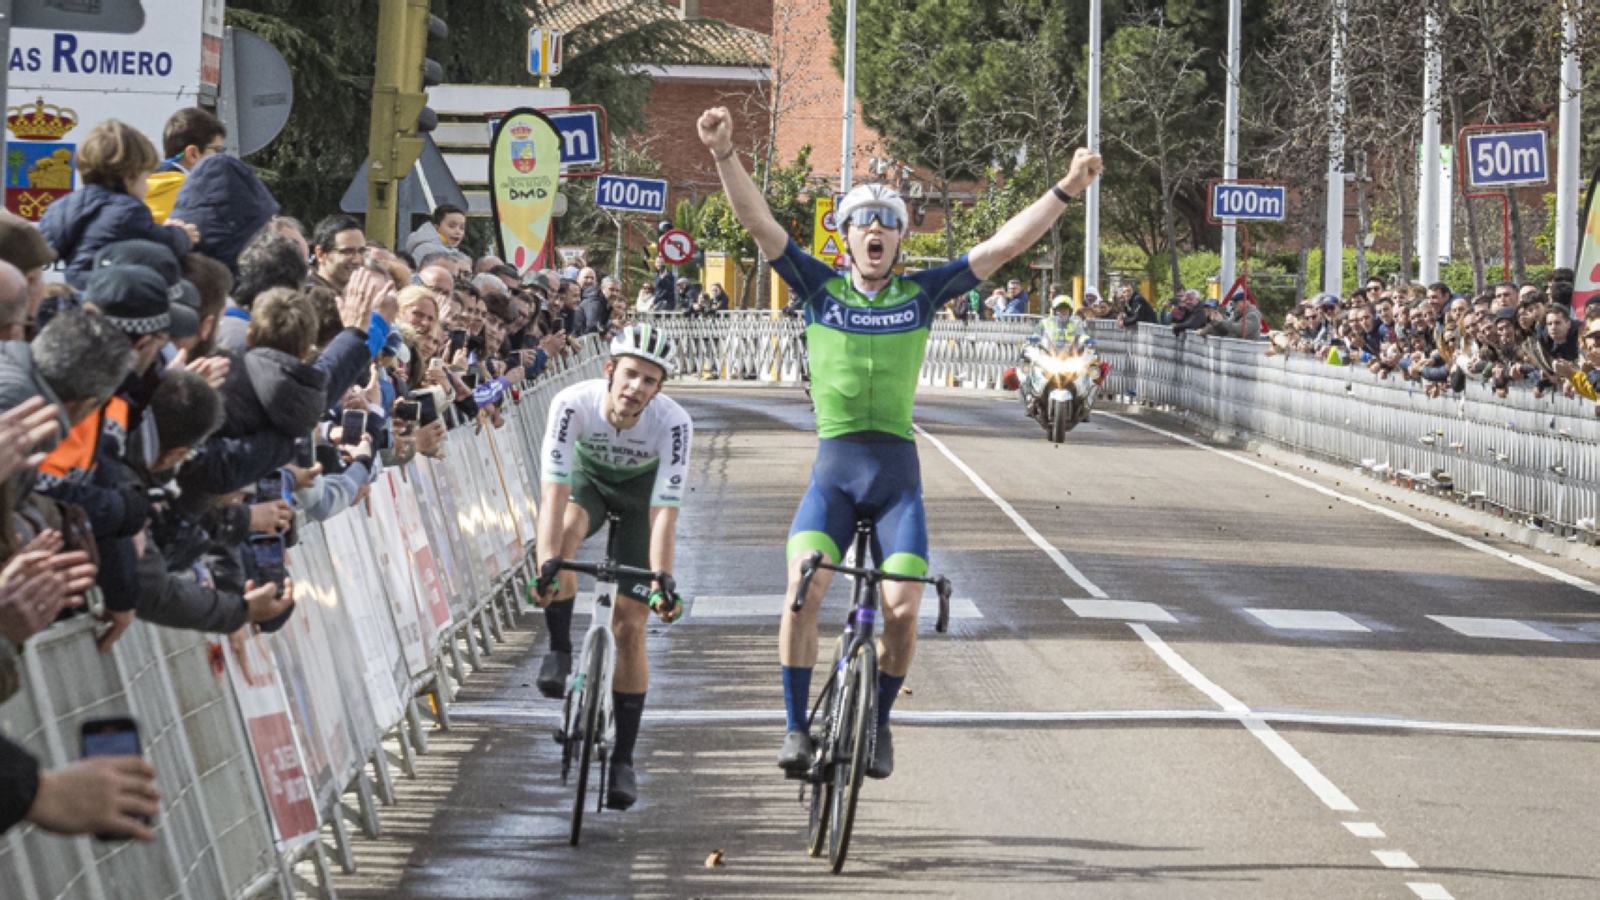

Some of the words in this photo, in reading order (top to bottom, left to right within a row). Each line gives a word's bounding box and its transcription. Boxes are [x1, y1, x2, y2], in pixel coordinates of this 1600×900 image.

[53, 33, 172, 76] ROMERO
[1476, 141, 1540, 176] 50m
[601, 181, 661, 208] 100m
[1219, 190, 1280, 215] 100m
[851, 309, 915, 326] CORTIZO
